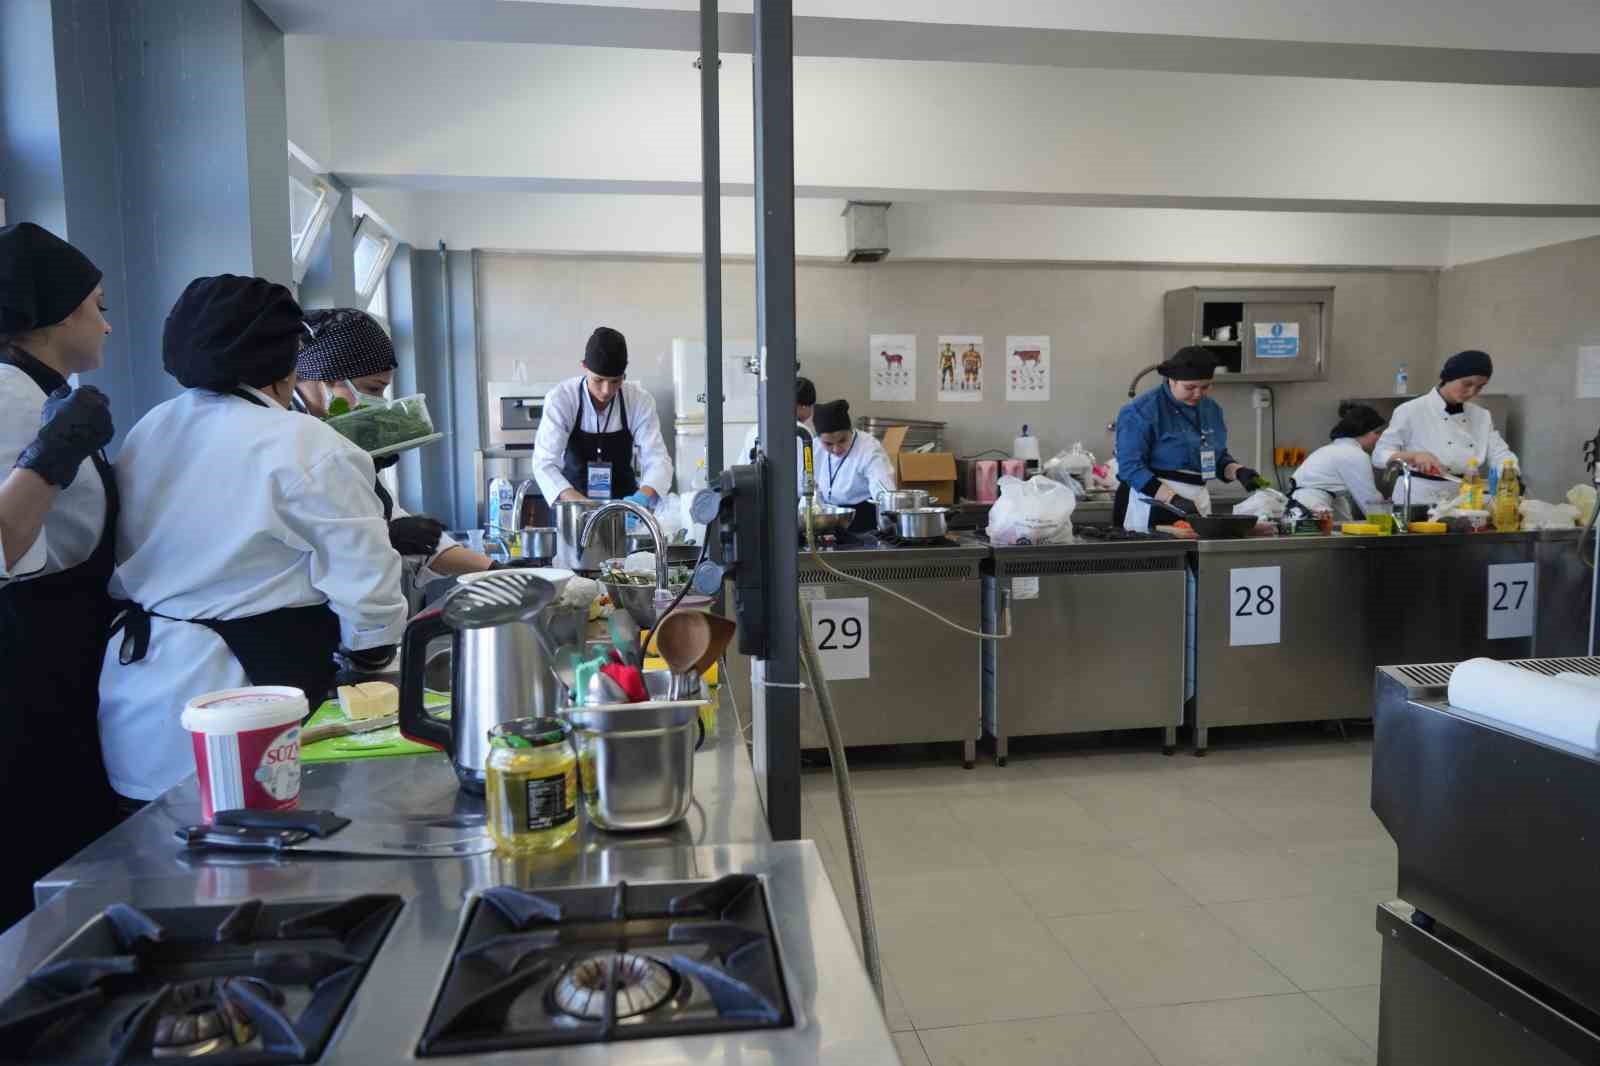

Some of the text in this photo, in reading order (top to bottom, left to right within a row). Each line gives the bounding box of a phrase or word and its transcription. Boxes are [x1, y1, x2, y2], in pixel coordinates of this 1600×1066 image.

[1235, 585, 1274, 616] 28
[1492, 581, 1529, 610] 27
[818, 617, 862, 650] 29
